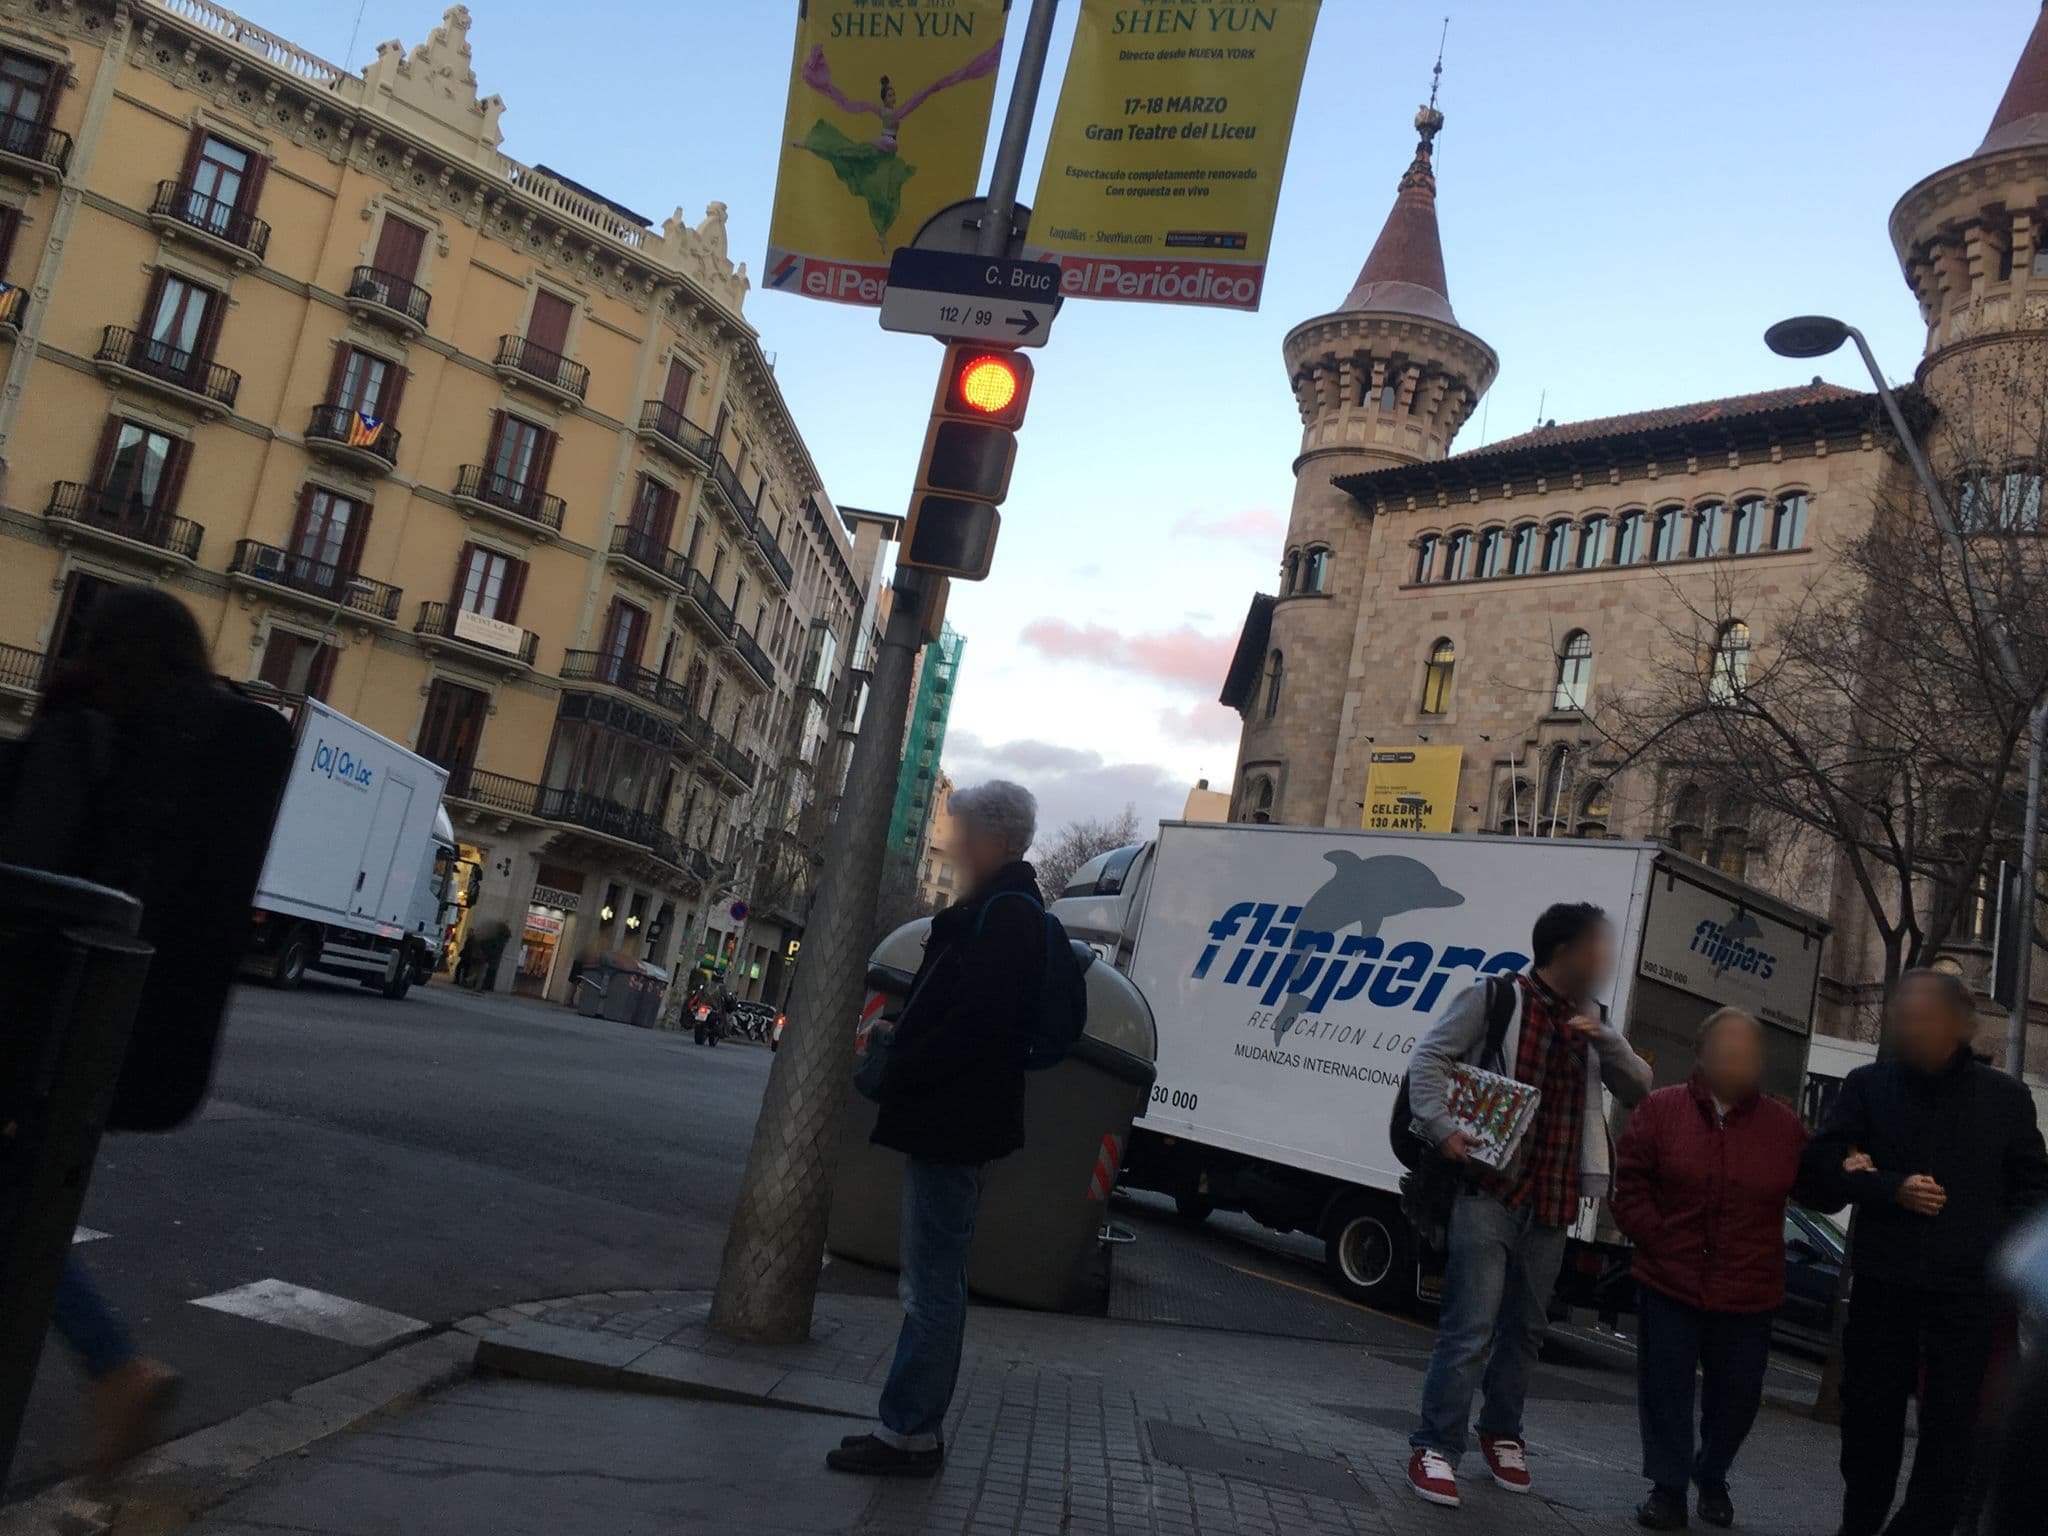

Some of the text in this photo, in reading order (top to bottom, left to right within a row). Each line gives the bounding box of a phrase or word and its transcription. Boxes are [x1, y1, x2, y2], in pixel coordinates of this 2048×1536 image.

[831, 11, 976, 38] SHEN YUN
[1112, 7, 1278, 35] SHEN YUN
[1119, 47, 1257, 61] Directo desde NUEVA YORK
[1124, 96, 1229, 115] 17-18 MARZO
[1085, 121, 1257, 141] Gran Teatre del Liceu
[1065, 165, 1258, 181] Espectaculo completamente renovado
[1105, 184, 1210, 199] Con orquesta en vivo
[1096, 230, 1153, 245] ShenYun.com
[985, 265, 1051, 290] C. Bruc
[939, 306, 960, 322] 112
[975, 309, 993, 326] 99
[1371, 804, 1433, 815] CELEBREM
[1370, 818, 1388, 828] 130
[787, 940, 801, 956] P
[1690, 920, 1777, 980] flippers
[1248, 1010, 1367, 1046] RELOCATION
[1234, 1043, 1301, 1069] MUDANZAS
[1172, 1089, 1198, 1111] 000
